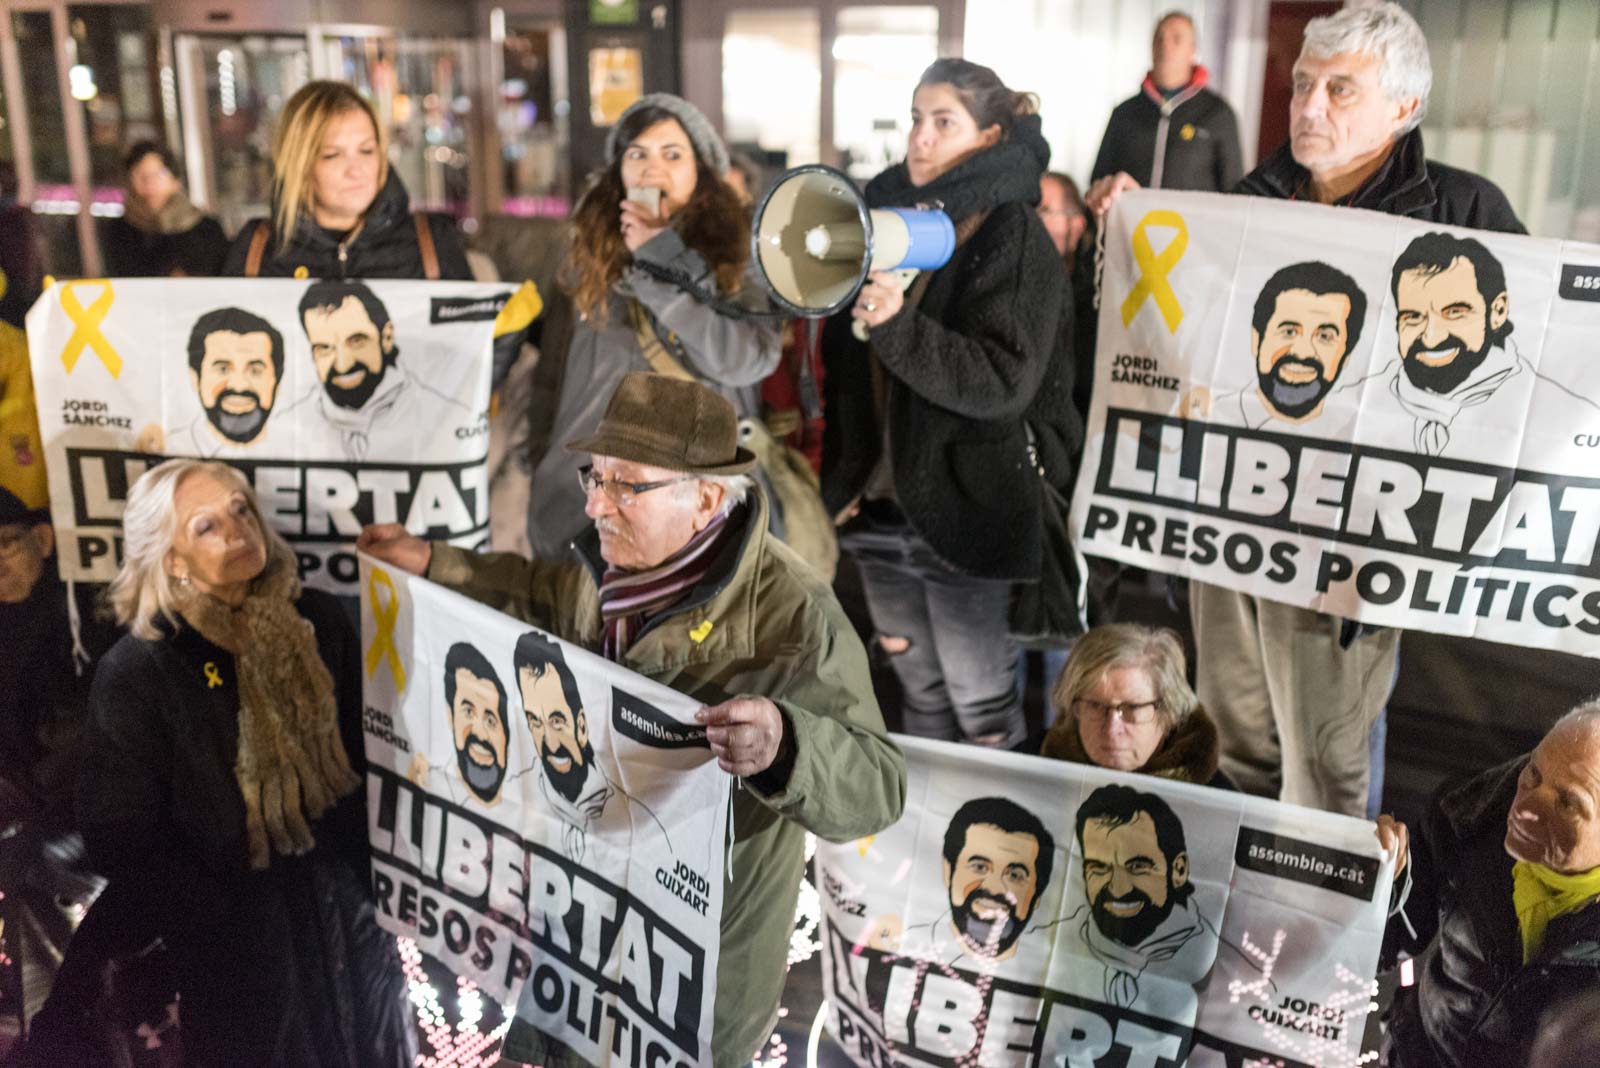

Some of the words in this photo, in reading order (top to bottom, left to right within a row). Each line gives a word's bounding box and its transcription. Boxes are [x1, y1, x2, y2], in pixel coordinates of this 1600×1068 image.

[1112, 354, 1158, 371] JORDI
[1108, 417, 1600, 567] LLIBERTAT
[1082, 503, 1301, 585] PRESOS
[1315, 549, 1600, 636] POLÍTICS
[672, 859, 710, 899] JORDI
[1247, 843, 1366, 885] assemblea.cat
[366, 769, 694, 1032] LLIBERTAT
[655, 867, 710, 917] CUIXART
